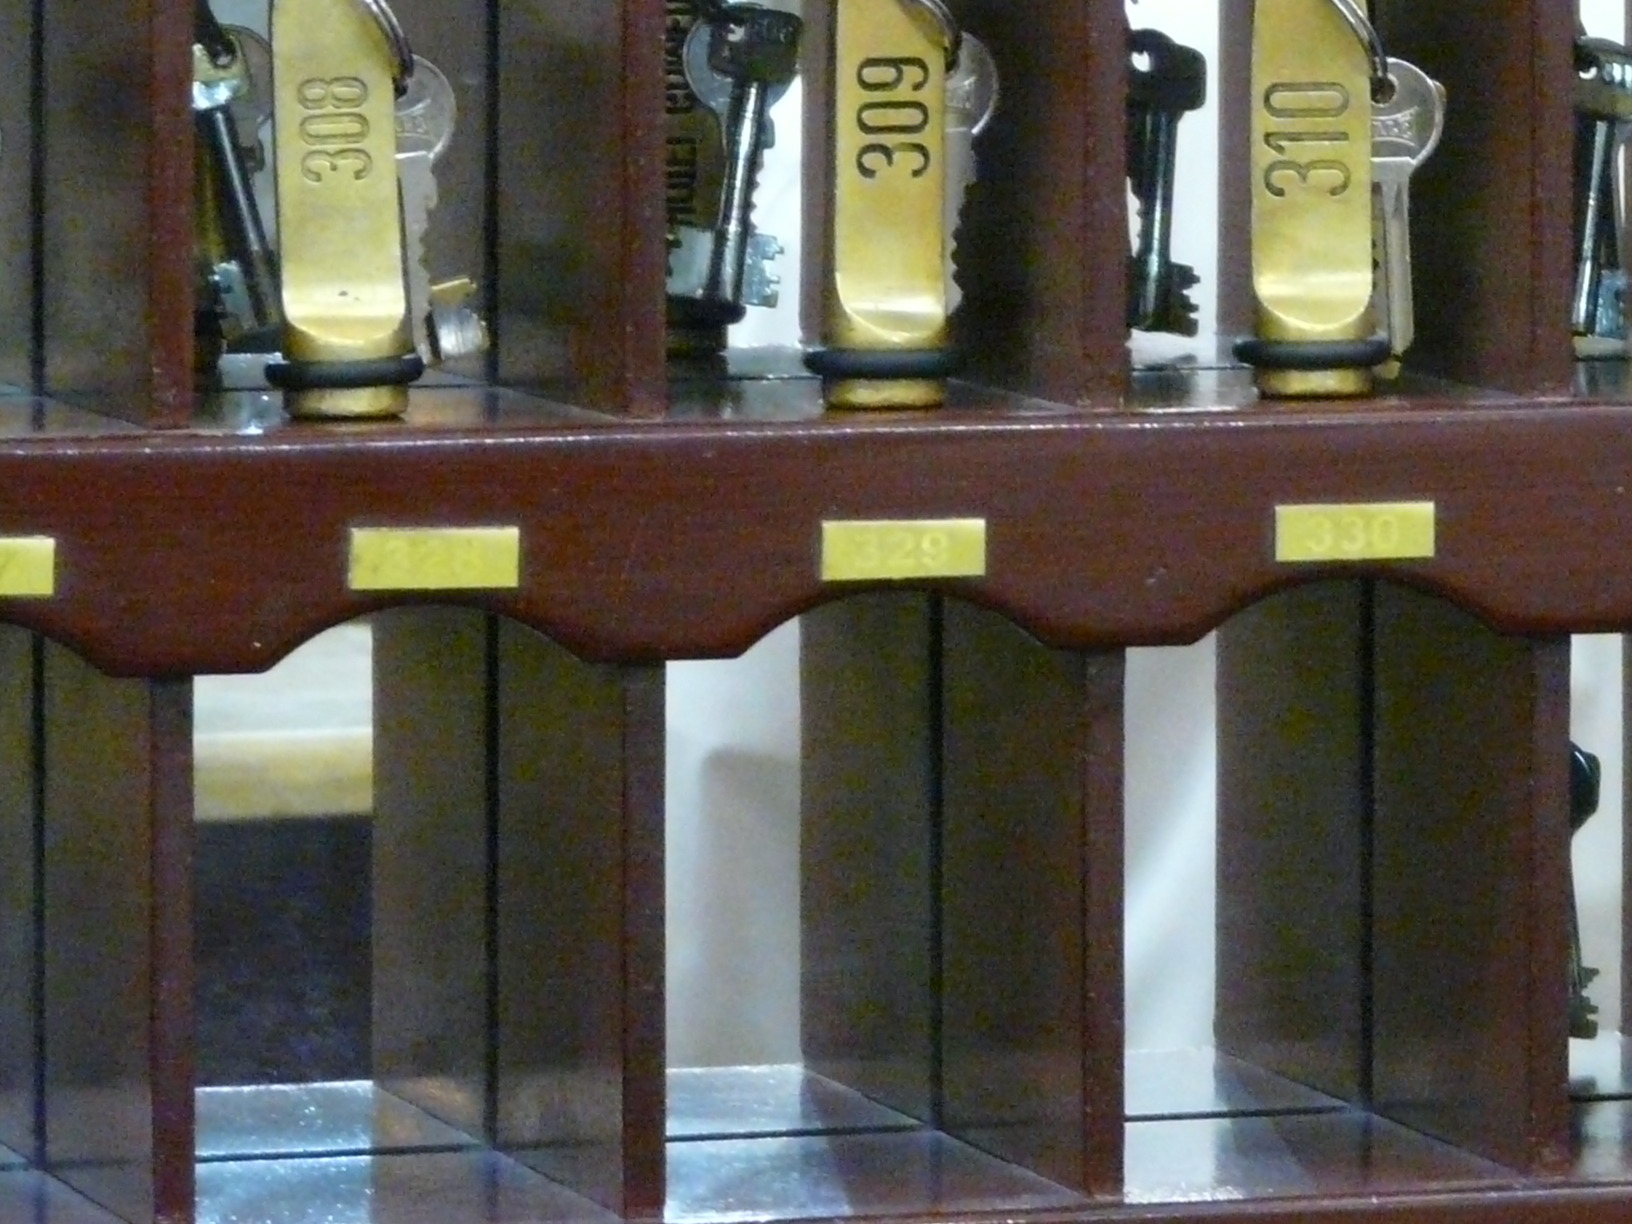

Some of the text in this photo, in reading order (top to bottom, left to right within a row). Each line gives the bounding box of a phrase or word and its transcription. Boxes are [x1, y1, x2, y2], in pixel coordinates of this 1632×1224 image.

[299, 74, 371, 185] 308
[855, 55, 931, 181] 309
[1262, 80, 1350, 199] 310
[1304, 513, 1399, 554] 330
